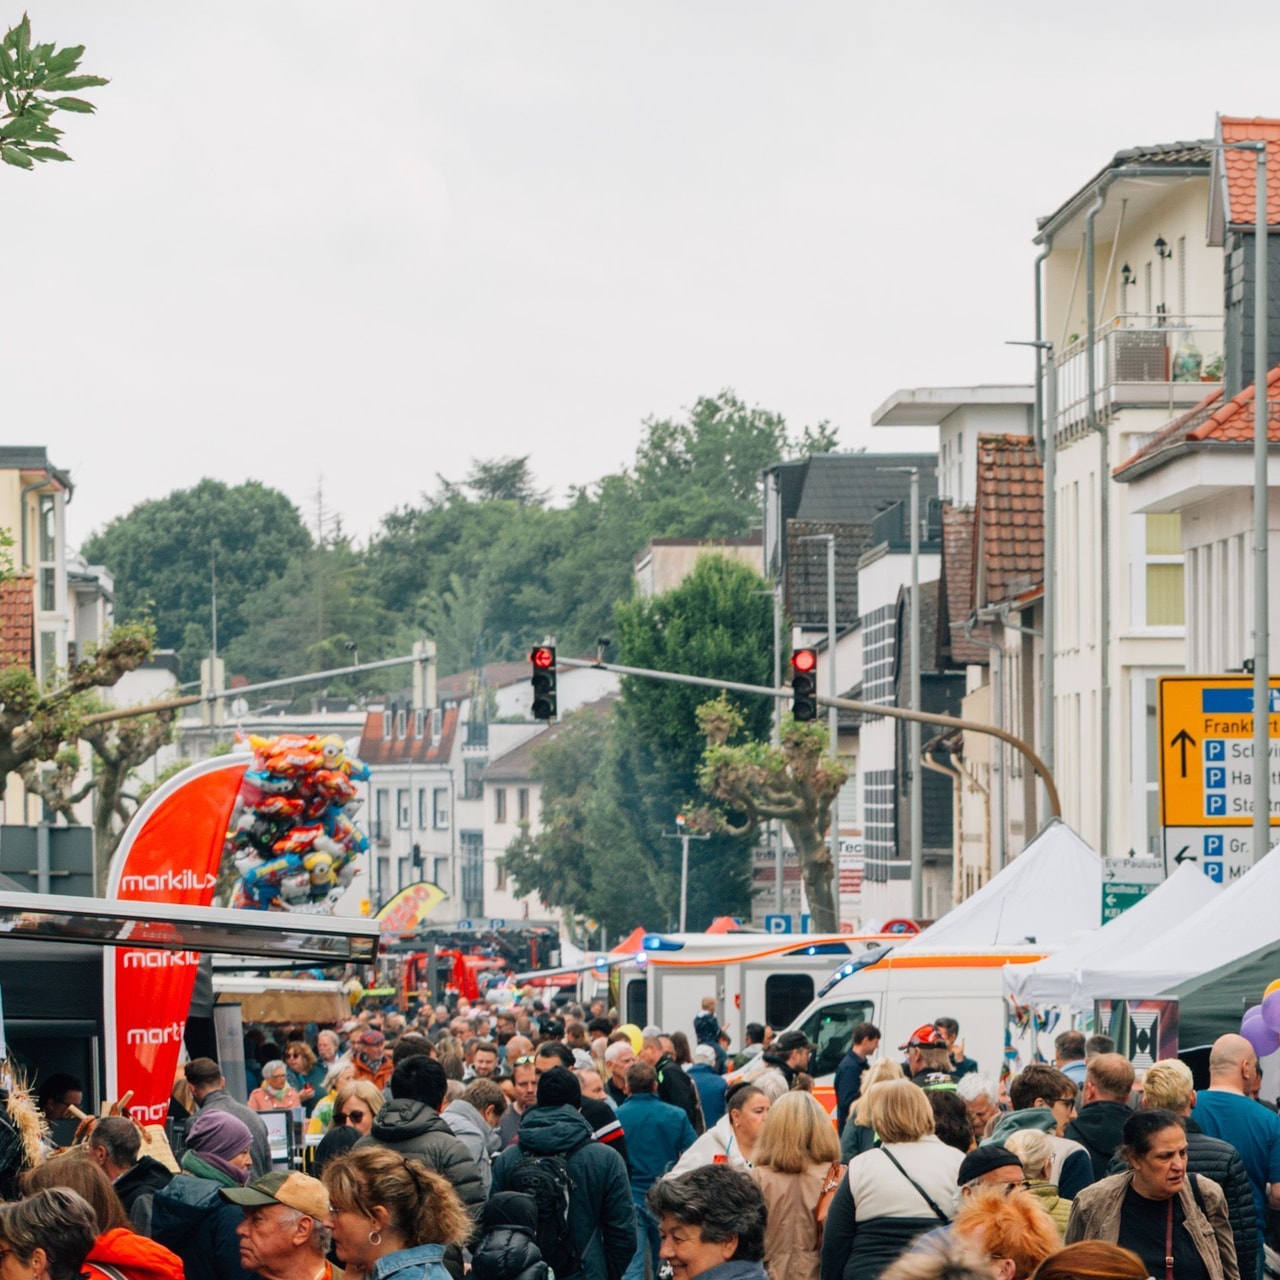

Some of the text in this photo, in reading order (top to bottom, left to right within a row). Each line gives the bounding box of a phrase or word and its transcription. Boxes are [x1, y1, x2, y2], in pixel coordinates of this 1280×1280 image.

[1210, 743, 1220, 759] P
[1211, 770, 1221, 785] P
[1211, 797, 1222, 813] P
[1208, 838, 1219, 853] P
[1230, 839, 1249, 853] Gr.
[1208, 865, 1219, 880] P
